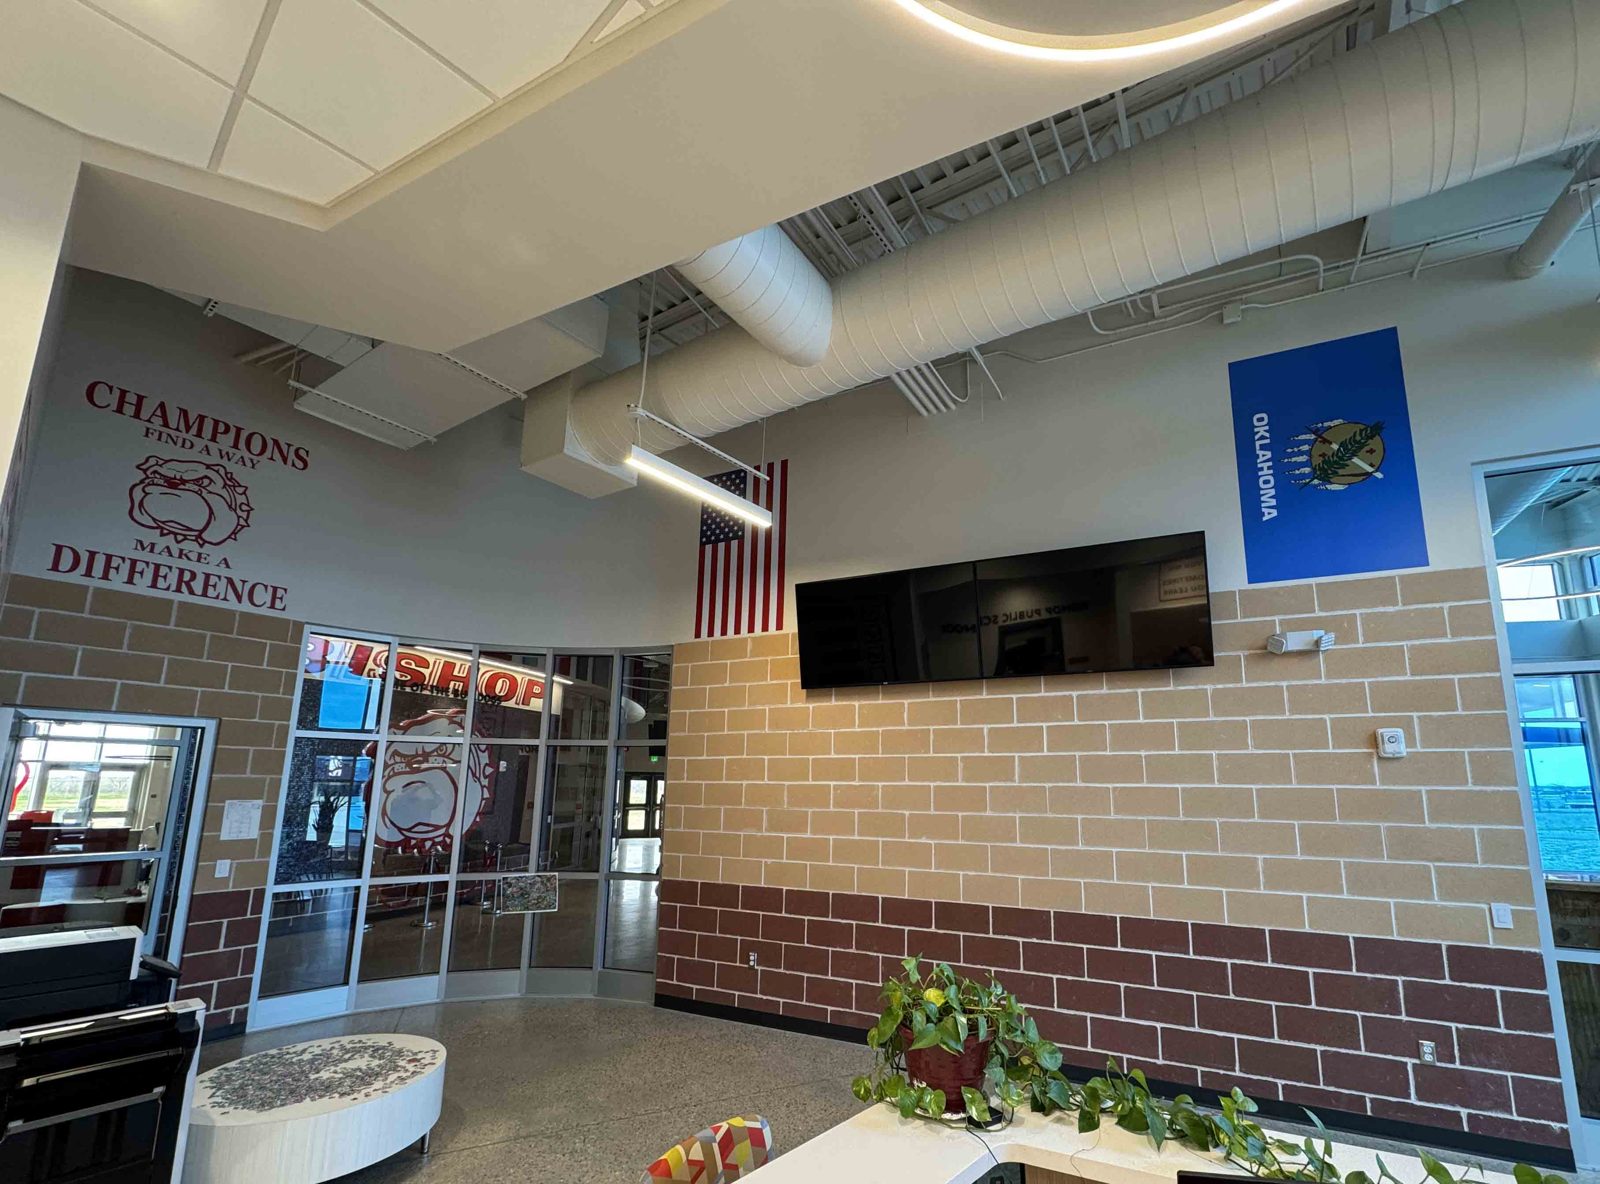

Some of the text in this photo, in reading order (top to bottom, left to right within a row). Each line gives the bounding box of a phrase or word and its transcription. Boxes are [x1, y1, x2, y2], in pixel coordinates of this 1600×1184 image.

[85, 380, 310, 471] CHAMPIONS
[143, 426, 261, 471] FIND A WAY
[1252, 412, 1278, 522] OKLAHOMA
[47, 543, 288, 612] DIFFERENCE
[133, 538, 233, 570] MAKE A
[451, 687, 502, 706] BUDOGS
